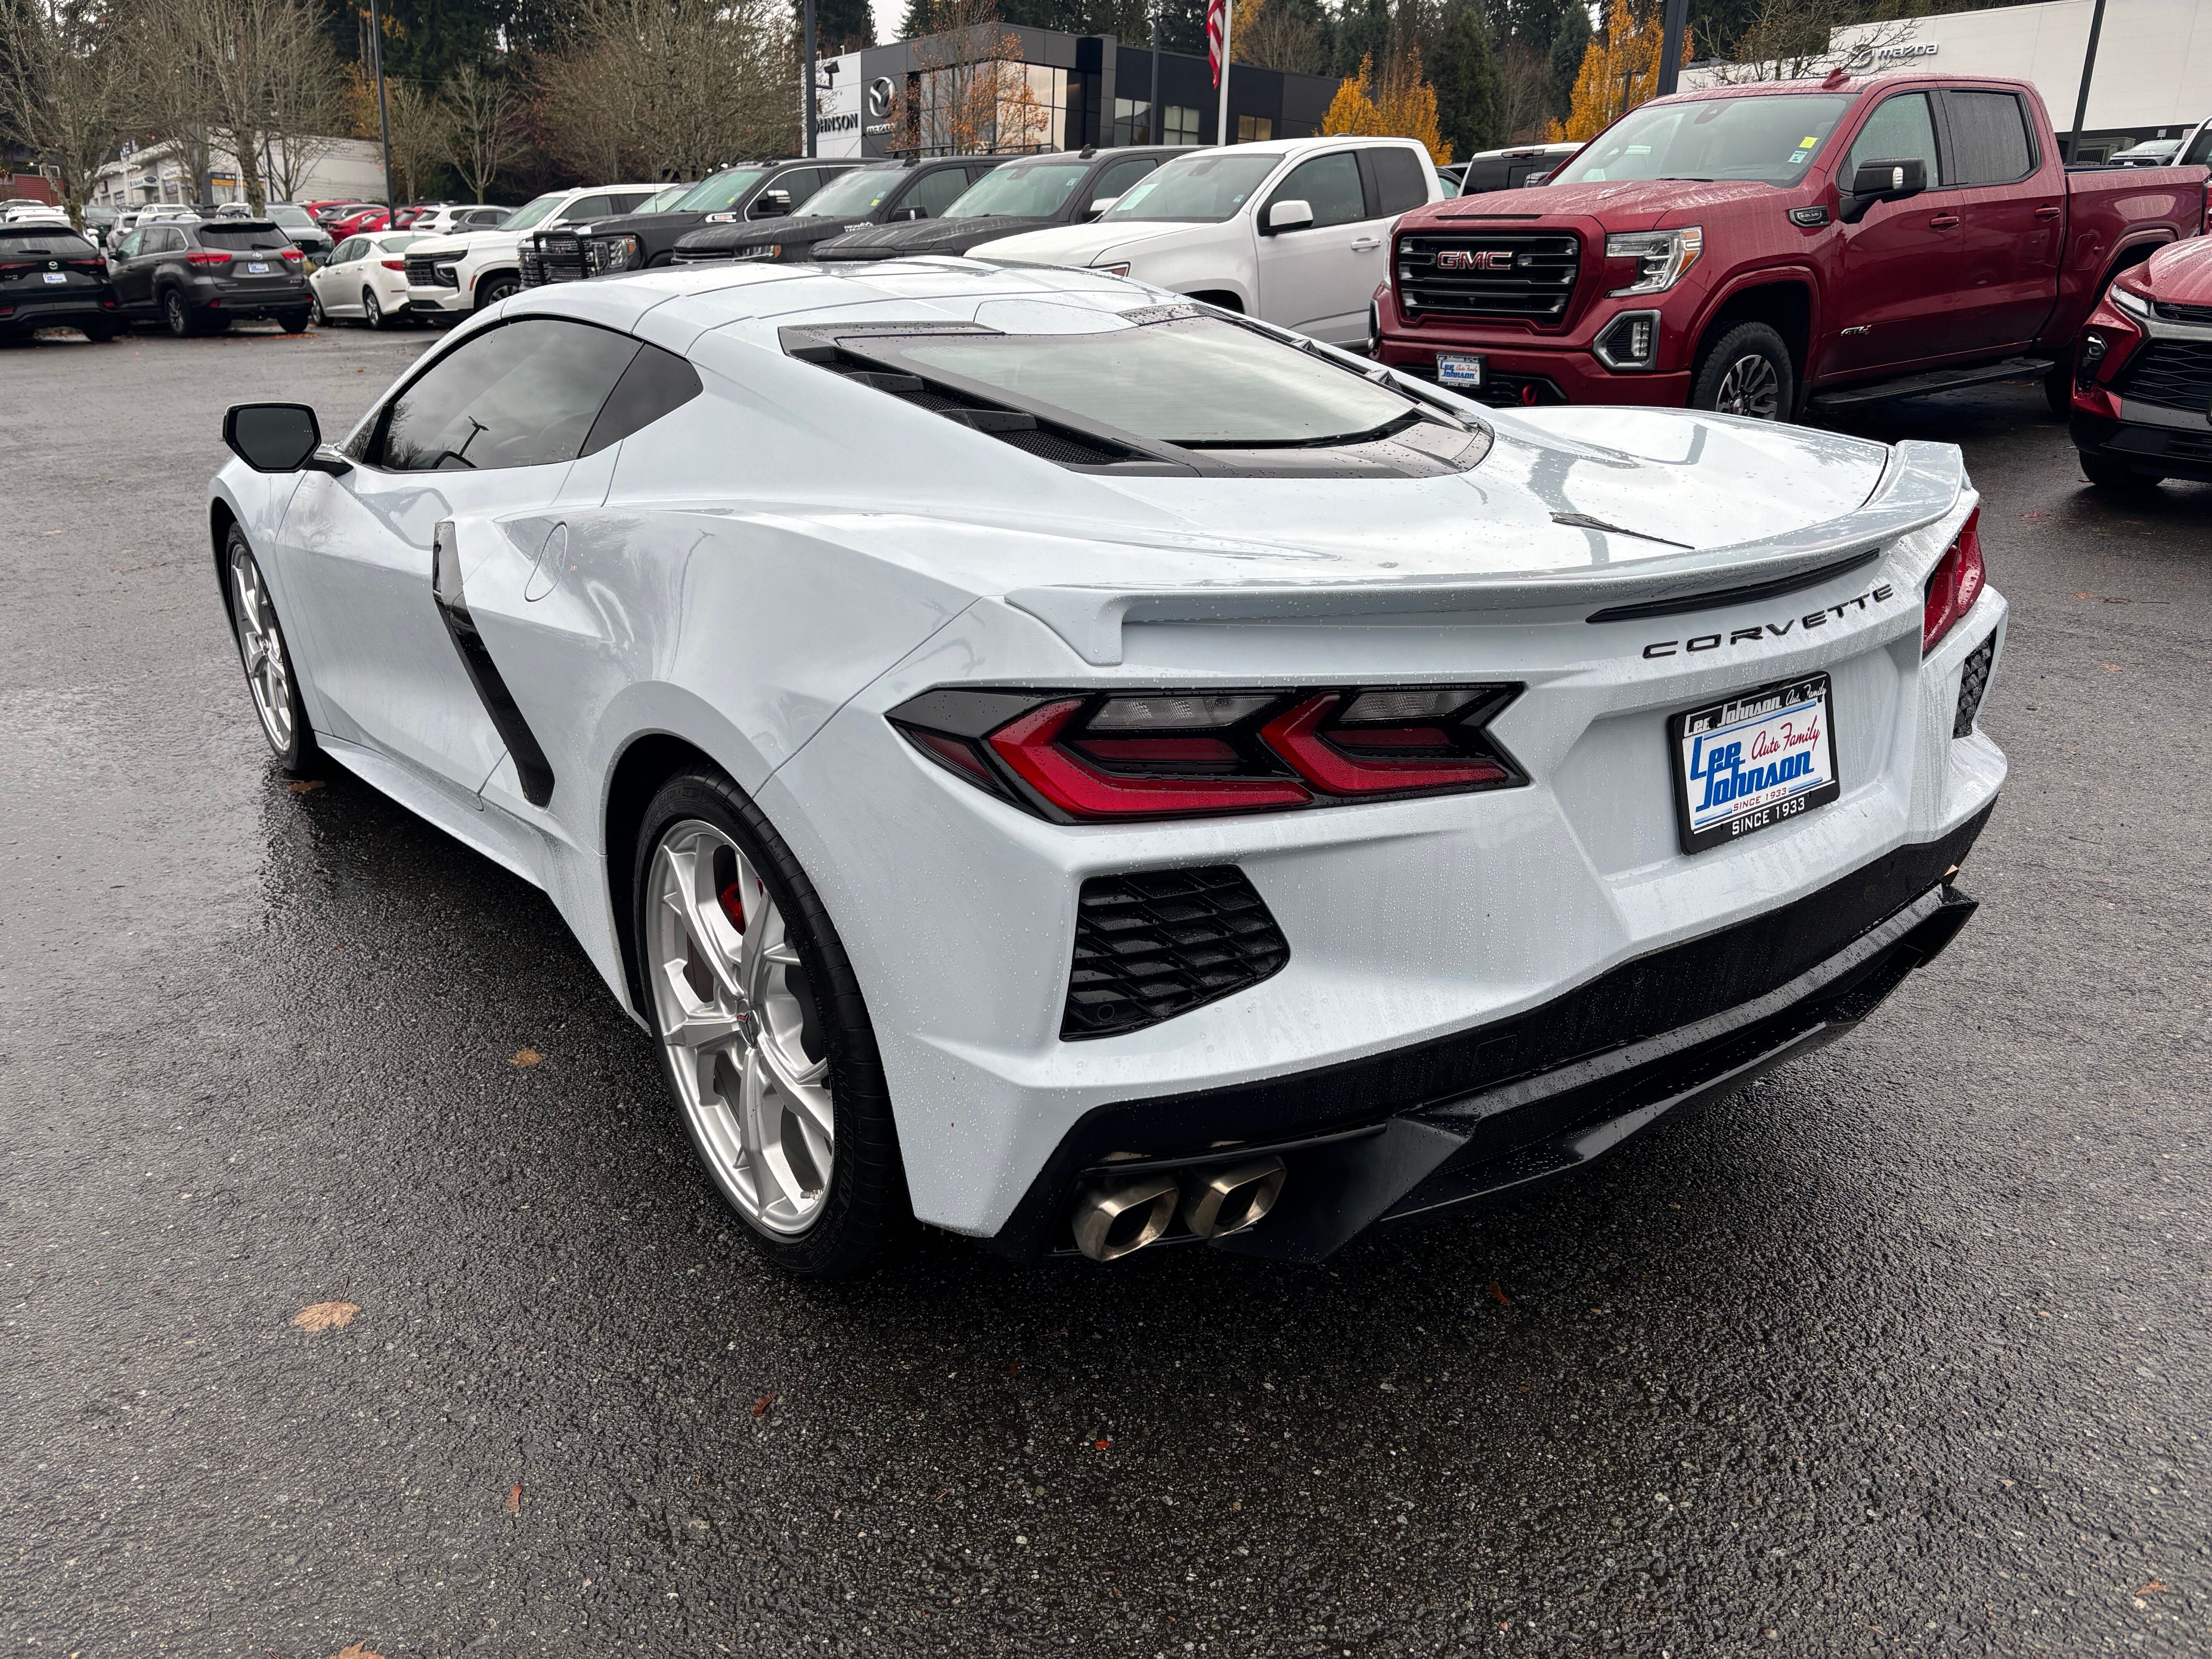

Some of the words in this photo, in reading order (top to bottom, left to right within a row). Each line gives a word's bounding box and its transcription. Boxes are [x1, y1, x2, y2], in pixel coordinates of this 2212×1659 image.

[1879, 43, 1939, 59] mazda
[1437, 251, 1513, 270] GMC
[1841, 325, 1872, 336] AT4
[1440, 360, 1455, 371] Lee
[1441, 370, 1476, 379] Johnson
[1643, 584, 1894, 659] CORVETTE
[1684, 714, 1716, 737] Lee
[1717, 696, 1782, 727] Johnson
[1751, 730, 1781, 760] Auto
[1780, 715, 1820, 752] Family
[1690, 736, 1745, 781] Lee
[1695, 750, 1815, 813] Johnson
[1733, 796, 1761, 812] SINCE
[1765, 787, 1787, 801] 1933
[1732, 809, 1770, 836] SINCE
[1775, 797, 1805, 819] 1933
